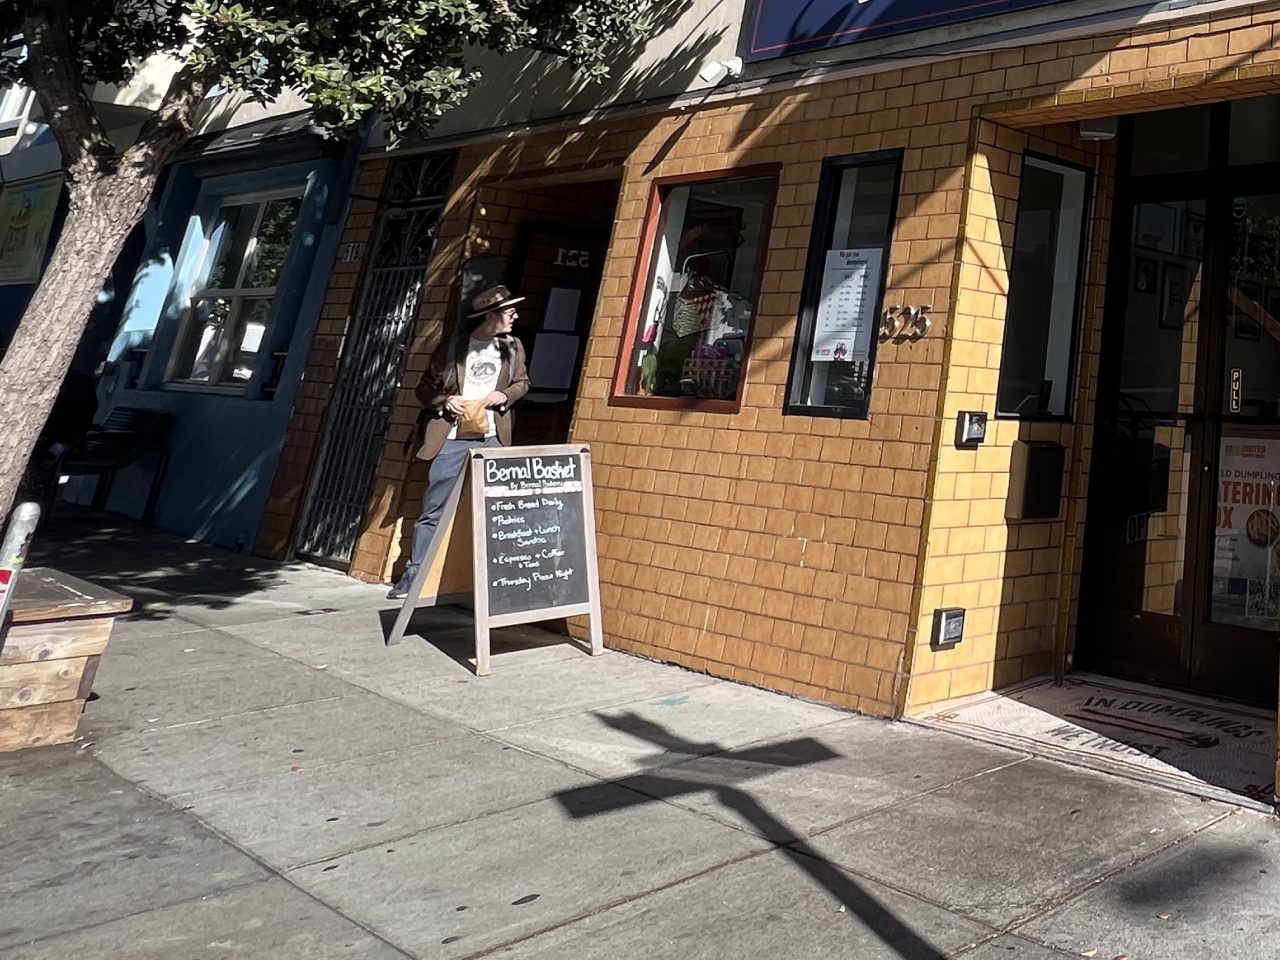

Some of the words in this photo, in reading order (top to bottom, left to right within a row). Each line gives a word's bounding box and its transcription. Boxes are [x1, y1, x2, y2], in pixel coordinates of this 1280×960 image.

[879, 305, 932, 345] 525
[1232, 371, 1240, 409] PULL
[487, 458, 531, 482] Bernal
[532, 457, 576, 479] Basket
[496, 501, 515, 511] Fresh
[518, 499, 539, 509] Bread
[541, 497, 564, 510] Daily
[497, 515, 525, 526] Pastries
[498, 527, 532, 540] Breakfast
[539, 525, 560, 534] Lunch
[498, 555, 532, 564] Espresso
[541, 548, 565, 559] Coffee
[498, 577, 531, 591] Thursday
[532, 572, 553, 581] Pizza
[555, 568, 574, 580] Night
[1084, 696, 1114, 709] IN
[1119, 700, 1264, 739] DUMPLINGS
[1047, 723, 1090, 742] WE
[1084, 734, 1171, 759] TRUST
